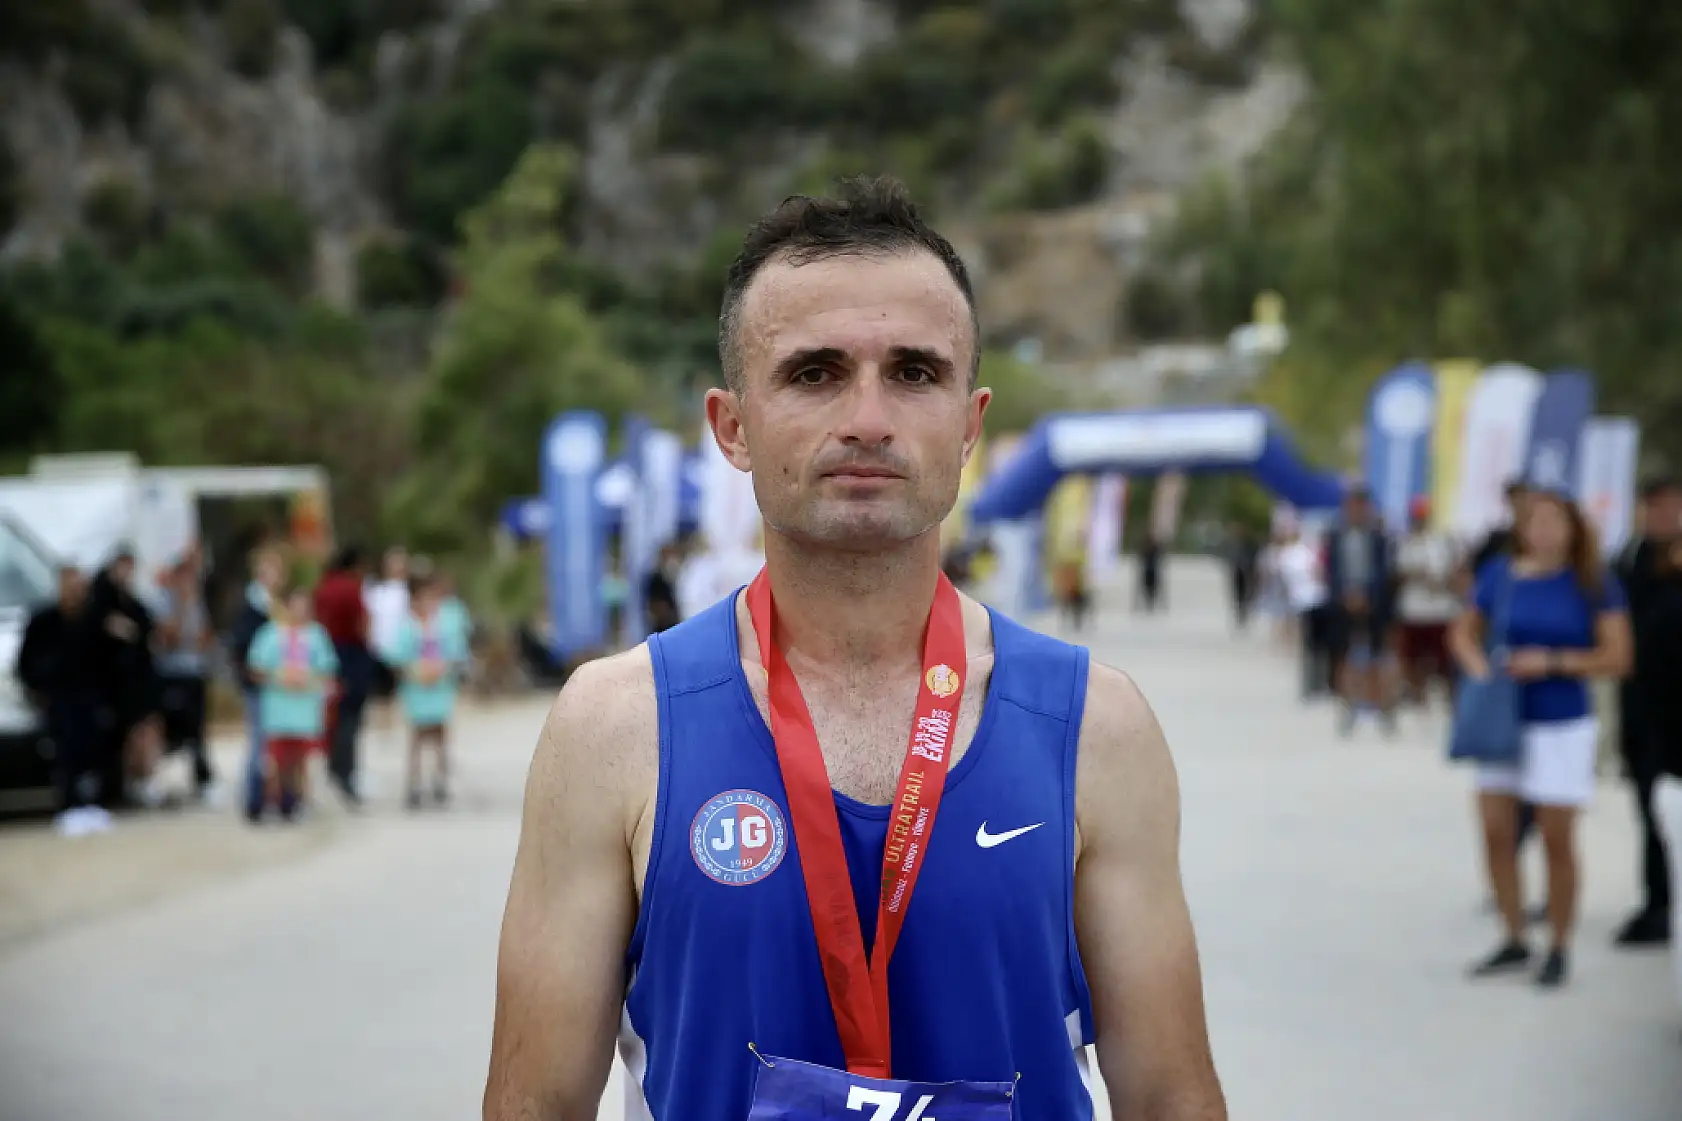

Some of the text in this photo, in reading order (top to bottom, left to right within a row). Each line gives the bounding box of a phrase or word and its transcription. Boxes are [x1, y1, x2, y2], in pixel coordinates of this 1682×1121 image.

[703, 793, 770, 817] JANDARMA
[886, 770, 925, 863] ULTRATRAIL
[712, 815, 767, 851] JG
[729, 857, 753, 869] 1949
